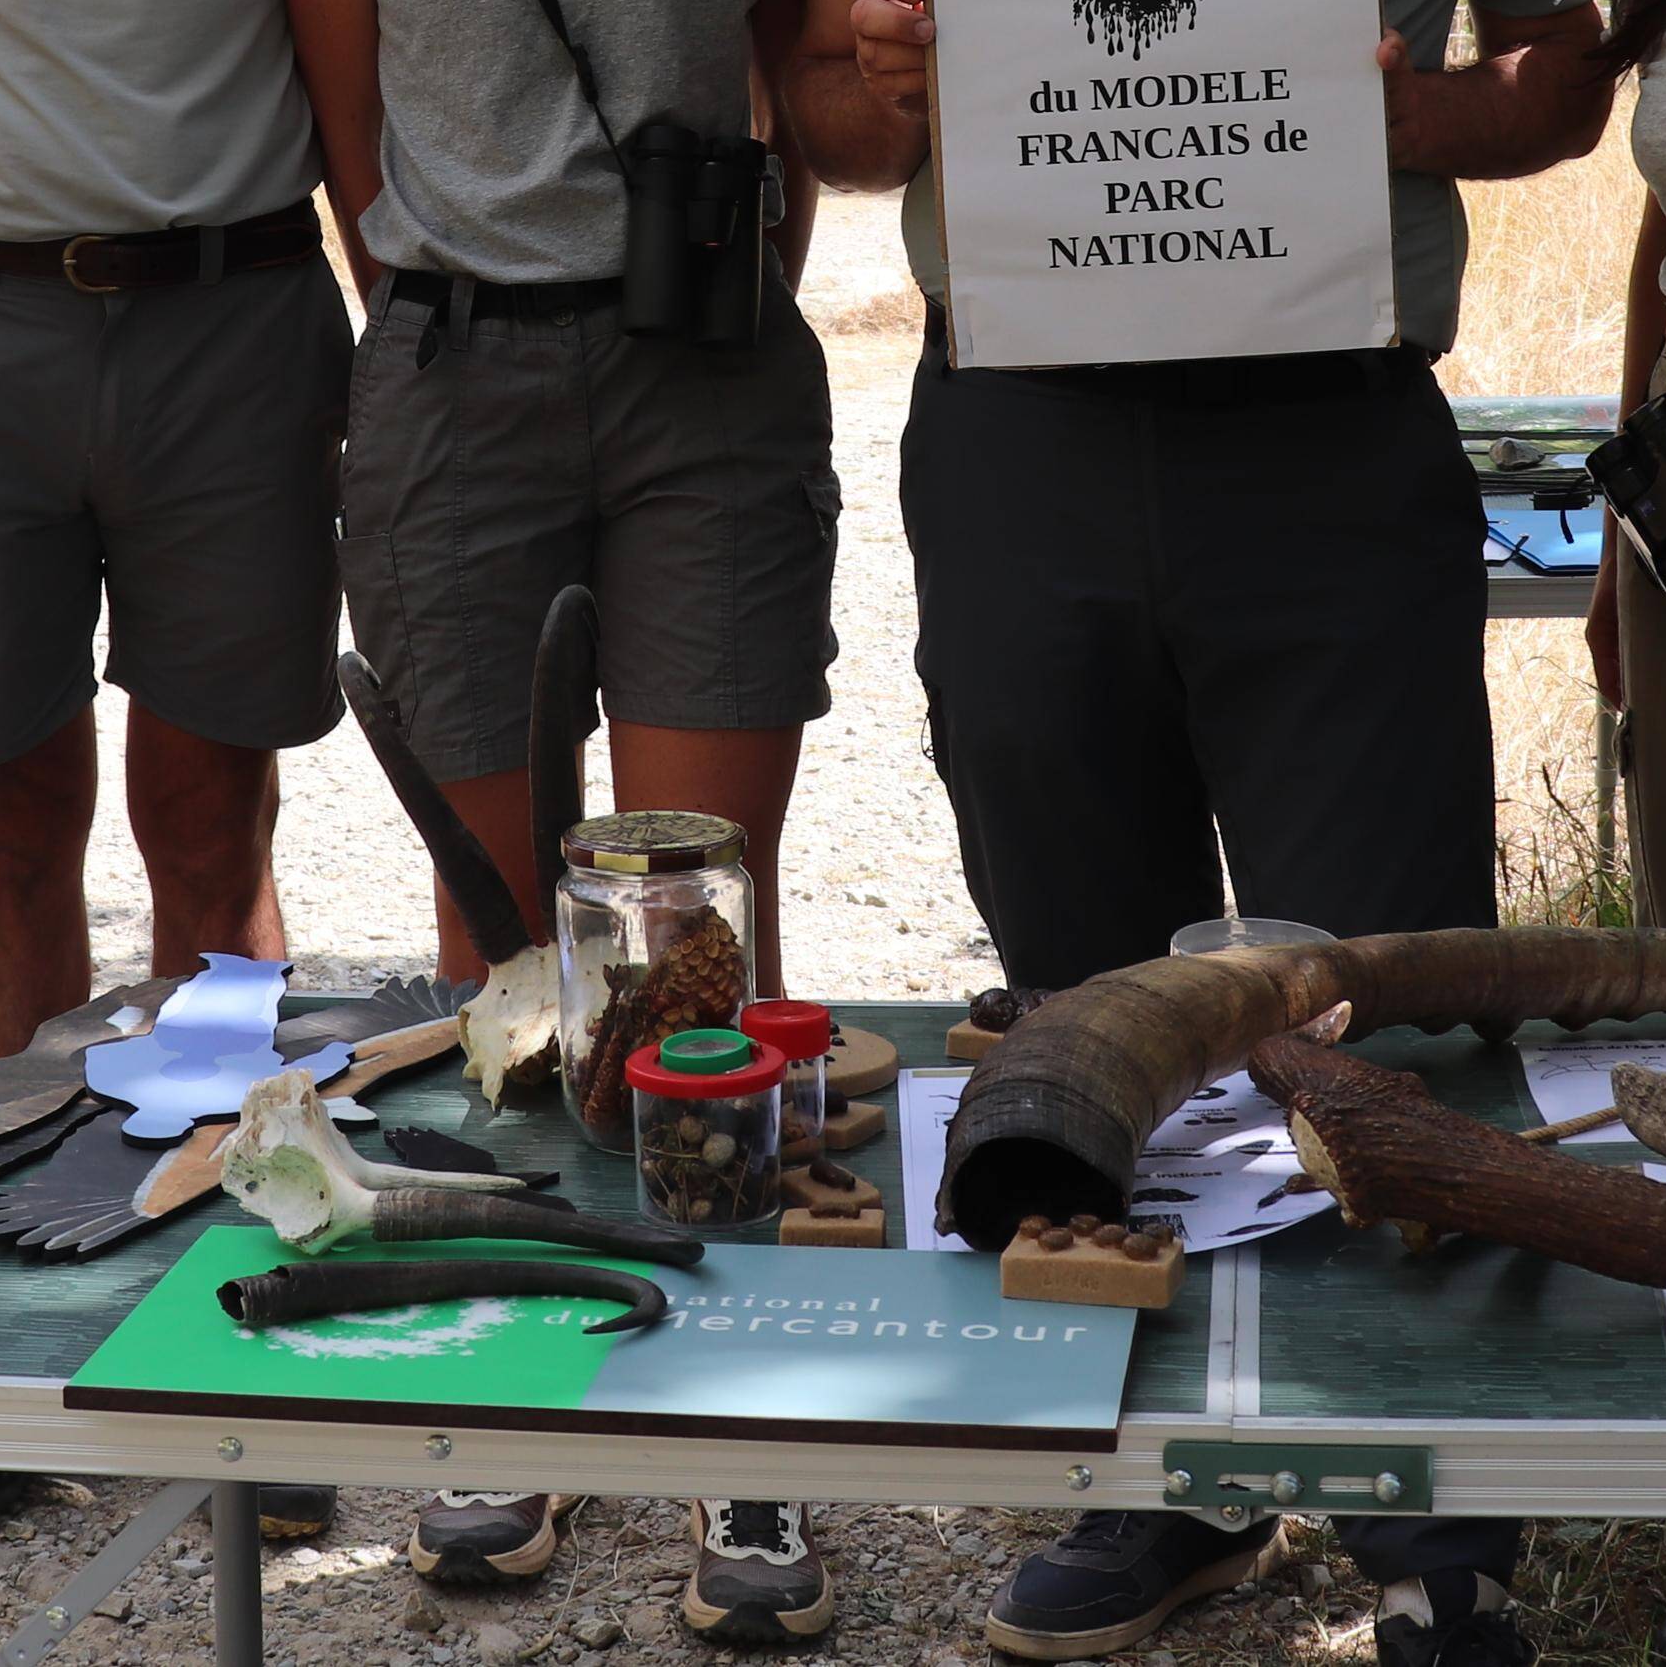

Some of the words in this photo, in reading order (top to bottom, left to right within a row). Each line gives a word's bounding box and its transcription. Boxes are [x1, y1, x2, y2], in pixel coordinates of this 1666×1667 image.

[1029, 80, 1078, 114] du
[1089, 68, 1290, 111] MODELE
[1017, 123, 1250, 167] FRANCAIS
[1264, 120, 1308, 153] de
[1104, 177, 1224, 215] PARC
[1048, 226, 1288, 269] NATIONAL
